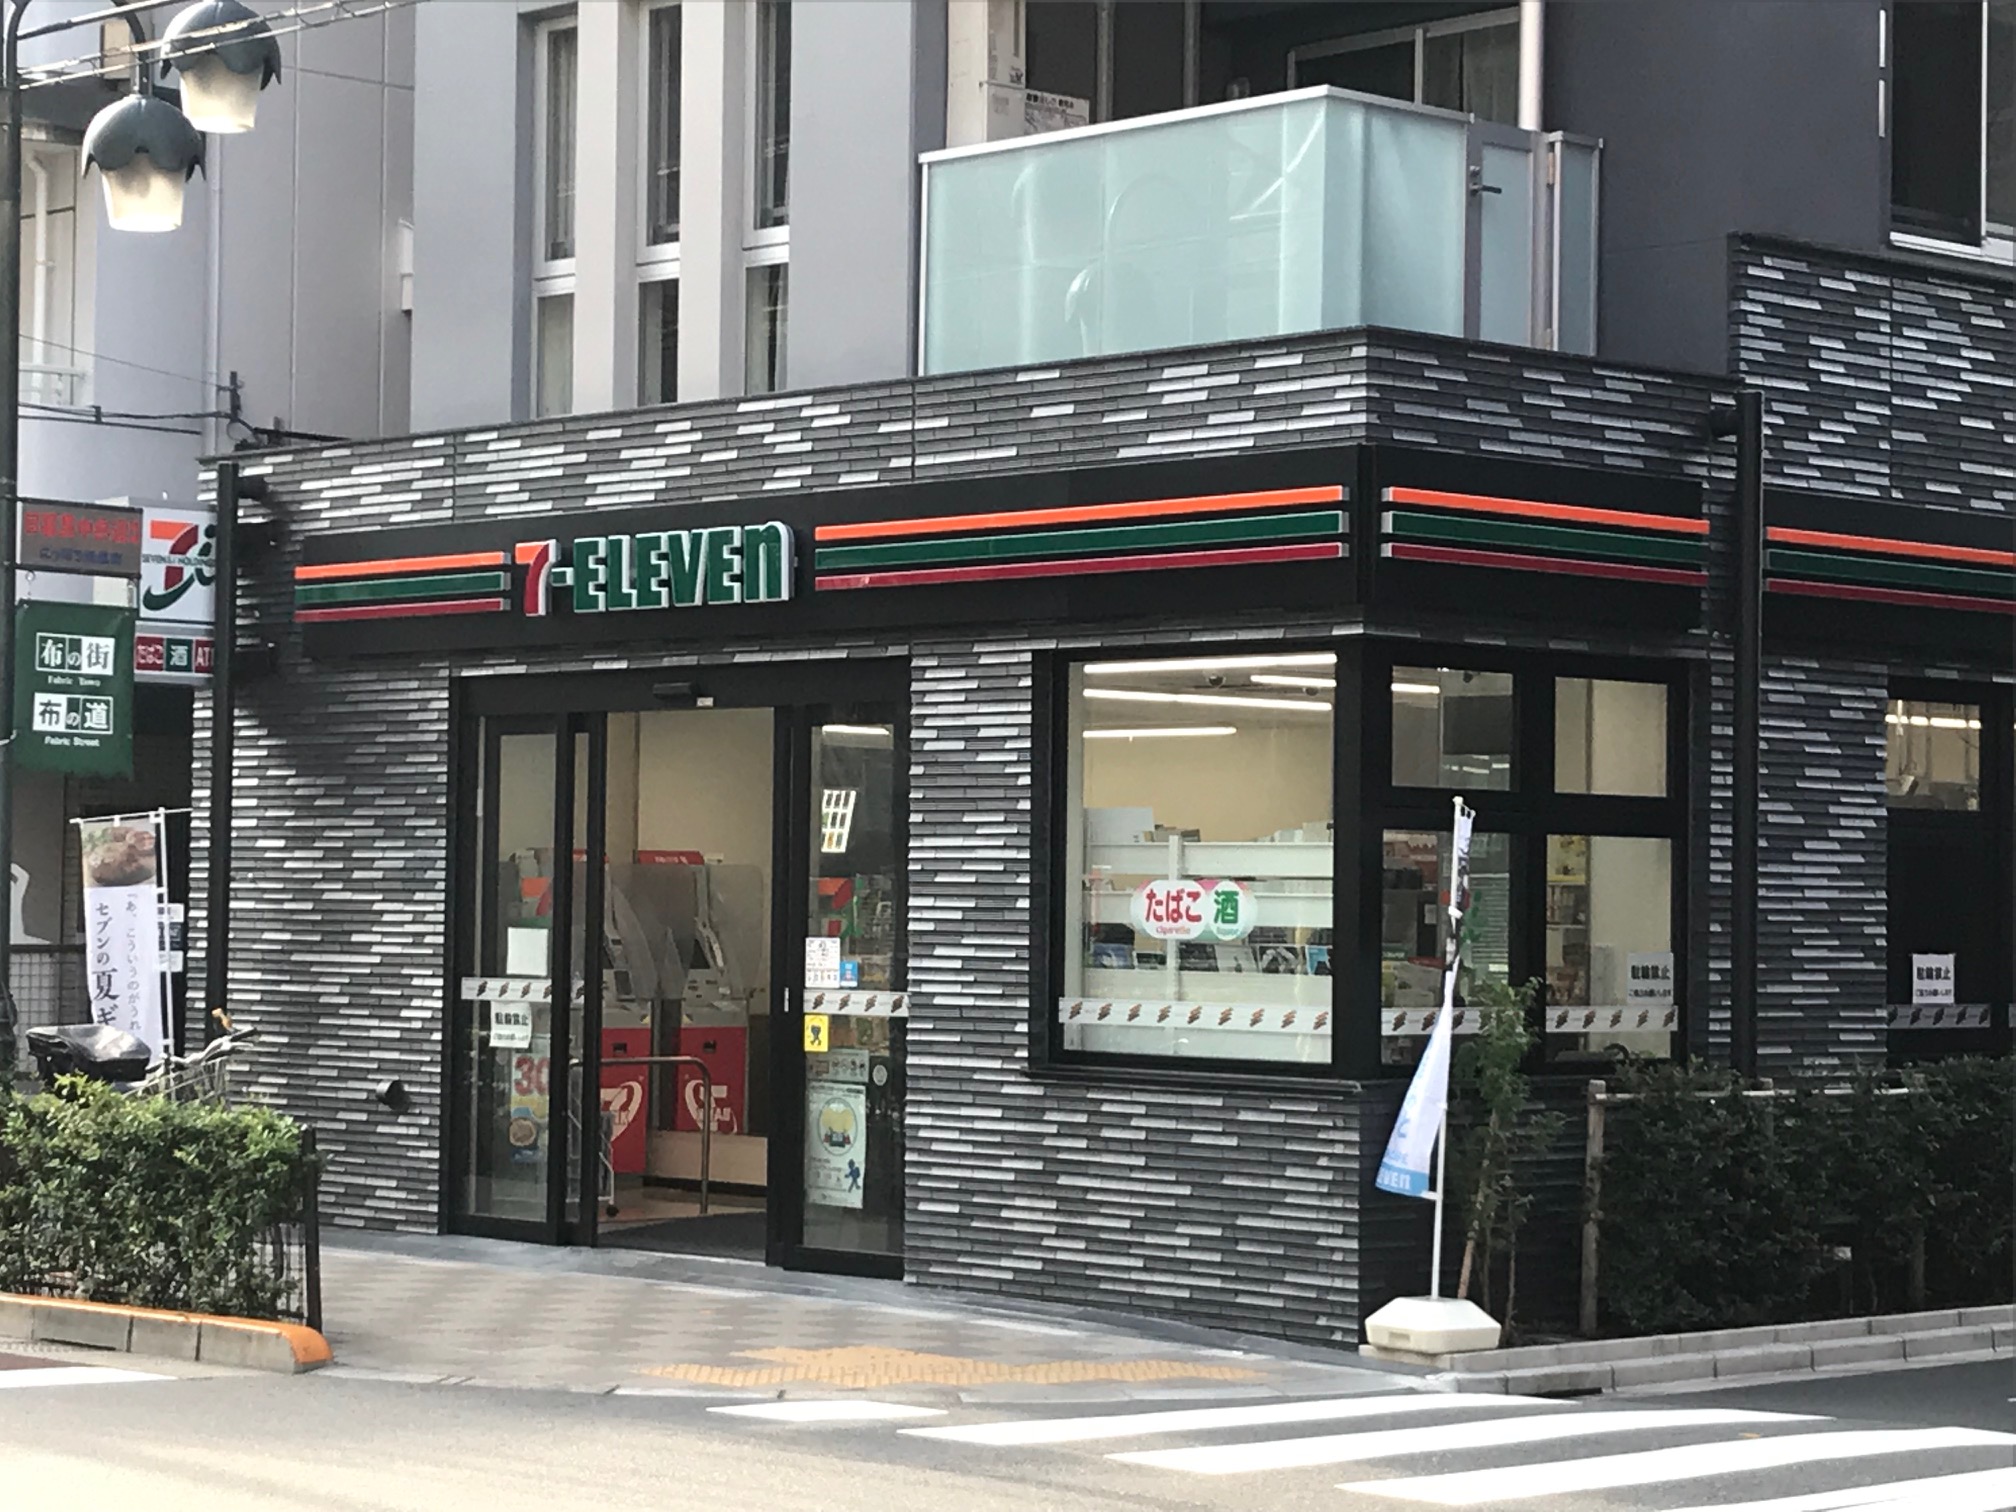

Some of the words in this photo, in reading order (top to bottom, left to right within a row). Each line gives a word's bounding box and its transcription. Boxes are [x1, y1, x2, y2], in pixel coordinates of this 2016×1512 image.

[40, 638, 111, 671] 布の街
[170, 644, 189, 667] 酒
[47, 675, 73, 685] Fabric
[38, 699, 109, 730] 布の道
[44, 735, 70, 746] Fabric
[73, 736, 100, 748] Street
[1145, 888, 1203, 923] たばこ
[1213, 889, 1240, 924] 酒
